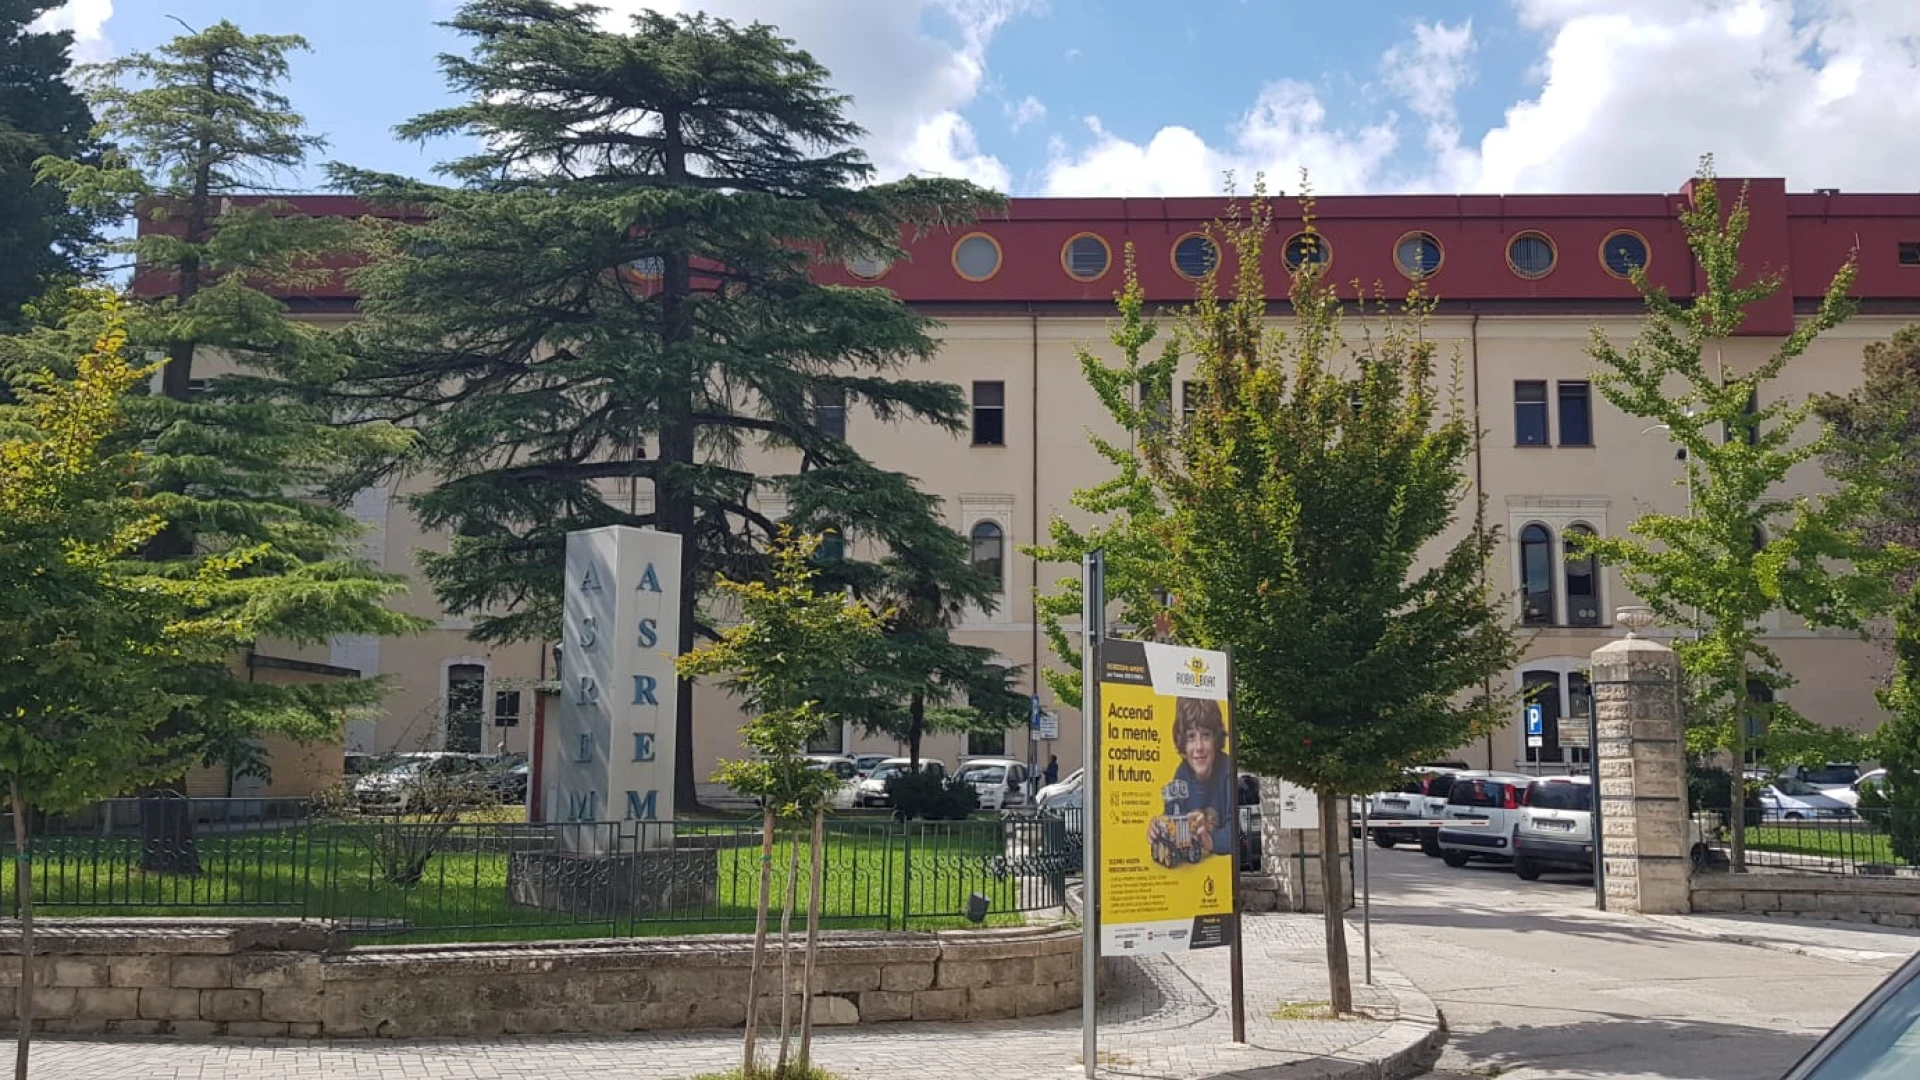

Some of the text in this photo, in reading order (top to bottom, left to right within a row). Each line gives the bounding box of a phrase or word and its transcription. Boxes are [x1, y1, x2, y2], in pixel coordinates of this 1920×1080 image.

[568, 561, 602, 821] ASREM
[624, 562, 663, 821] ASREM
[1108, 702, 1153, 720] Accendi
[1530, 708, 1539, 731] P
[1108, 722, 1161, 744] la mente,
[1108, 745, 1160, 762] costruisci
[1108, 764, 1155, 784] il futuro.
